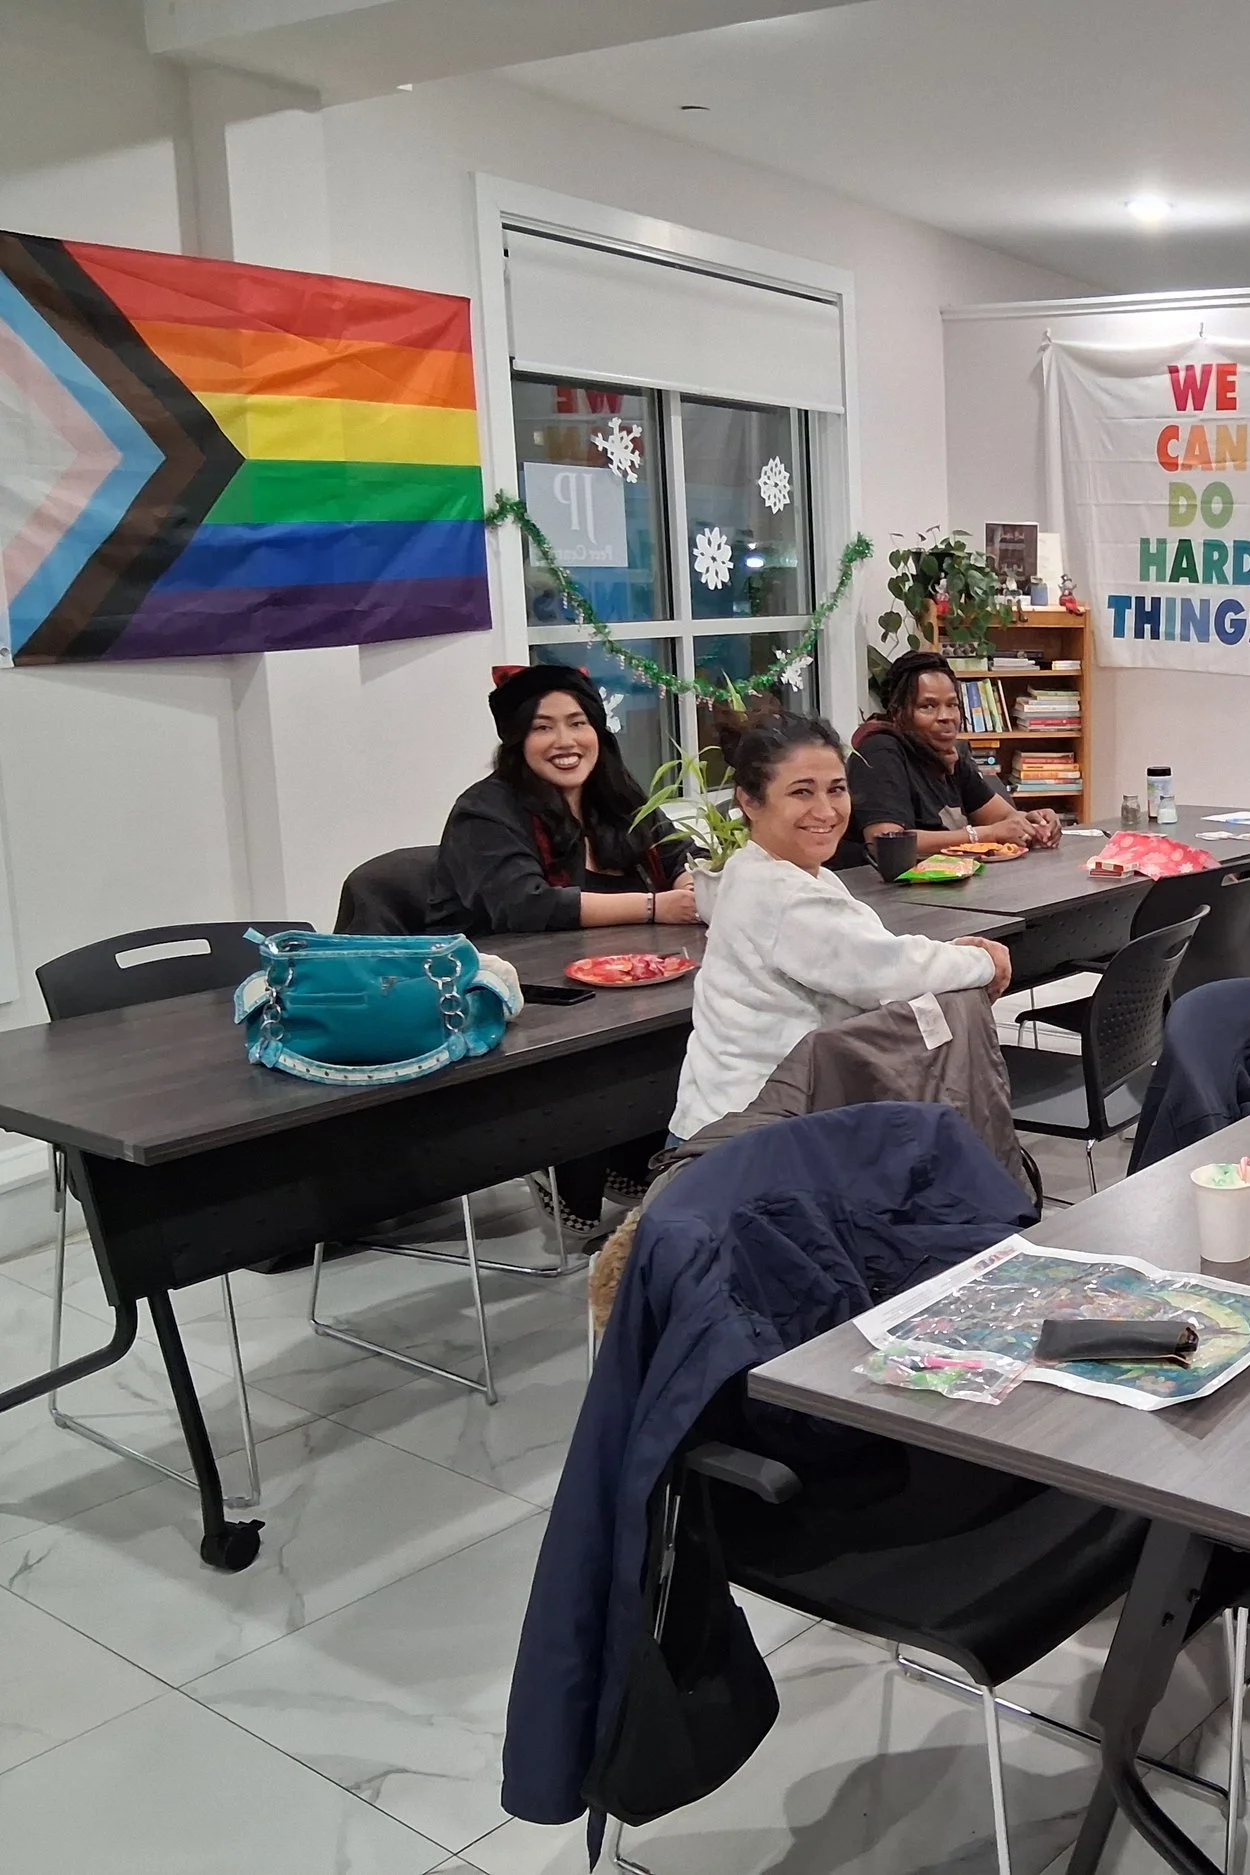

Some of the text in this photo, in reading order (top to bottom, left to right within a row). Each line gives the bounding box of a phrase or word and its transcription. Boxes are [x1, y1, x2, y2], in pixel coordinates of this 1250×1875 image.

[1167, 363, 1239, 412] WE
[1156, 423, 1248, 472] CAN
[1168, 481, 1234, 529] DO
